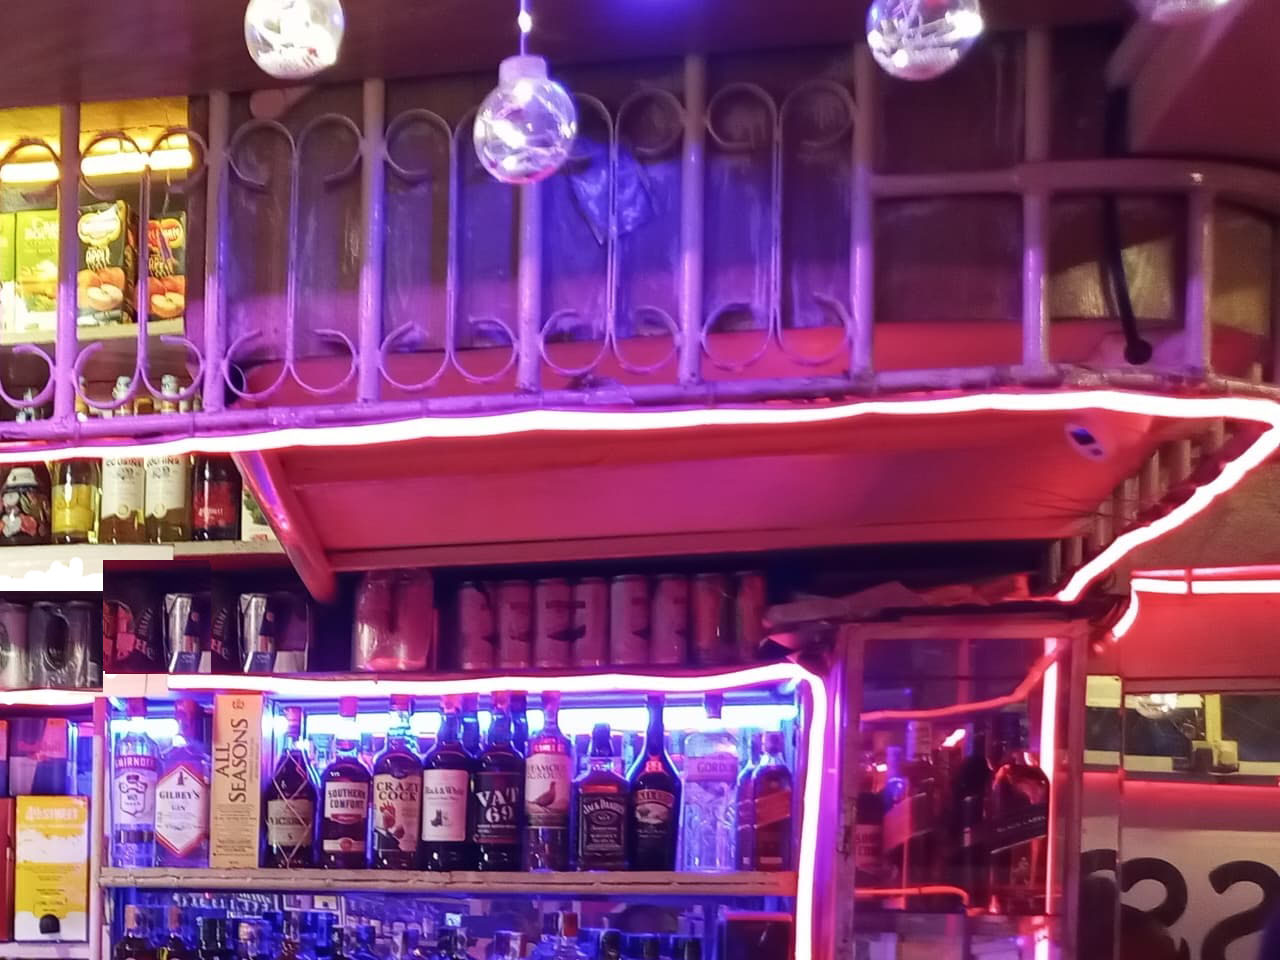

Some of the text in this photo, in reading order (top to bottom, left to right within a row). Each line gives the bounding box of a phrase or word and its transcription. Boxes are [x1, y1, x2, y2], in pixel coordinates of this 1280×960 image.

[215, 742, 230, 778] ALL
[229, 718, 248, 803] SEASONS
[328, 788, 366, 799] SOUTHERN
[378, 792, 417, 802] COCK
[476, 787, 519, 808] VAT
[486, 805, 514, 823] 69
